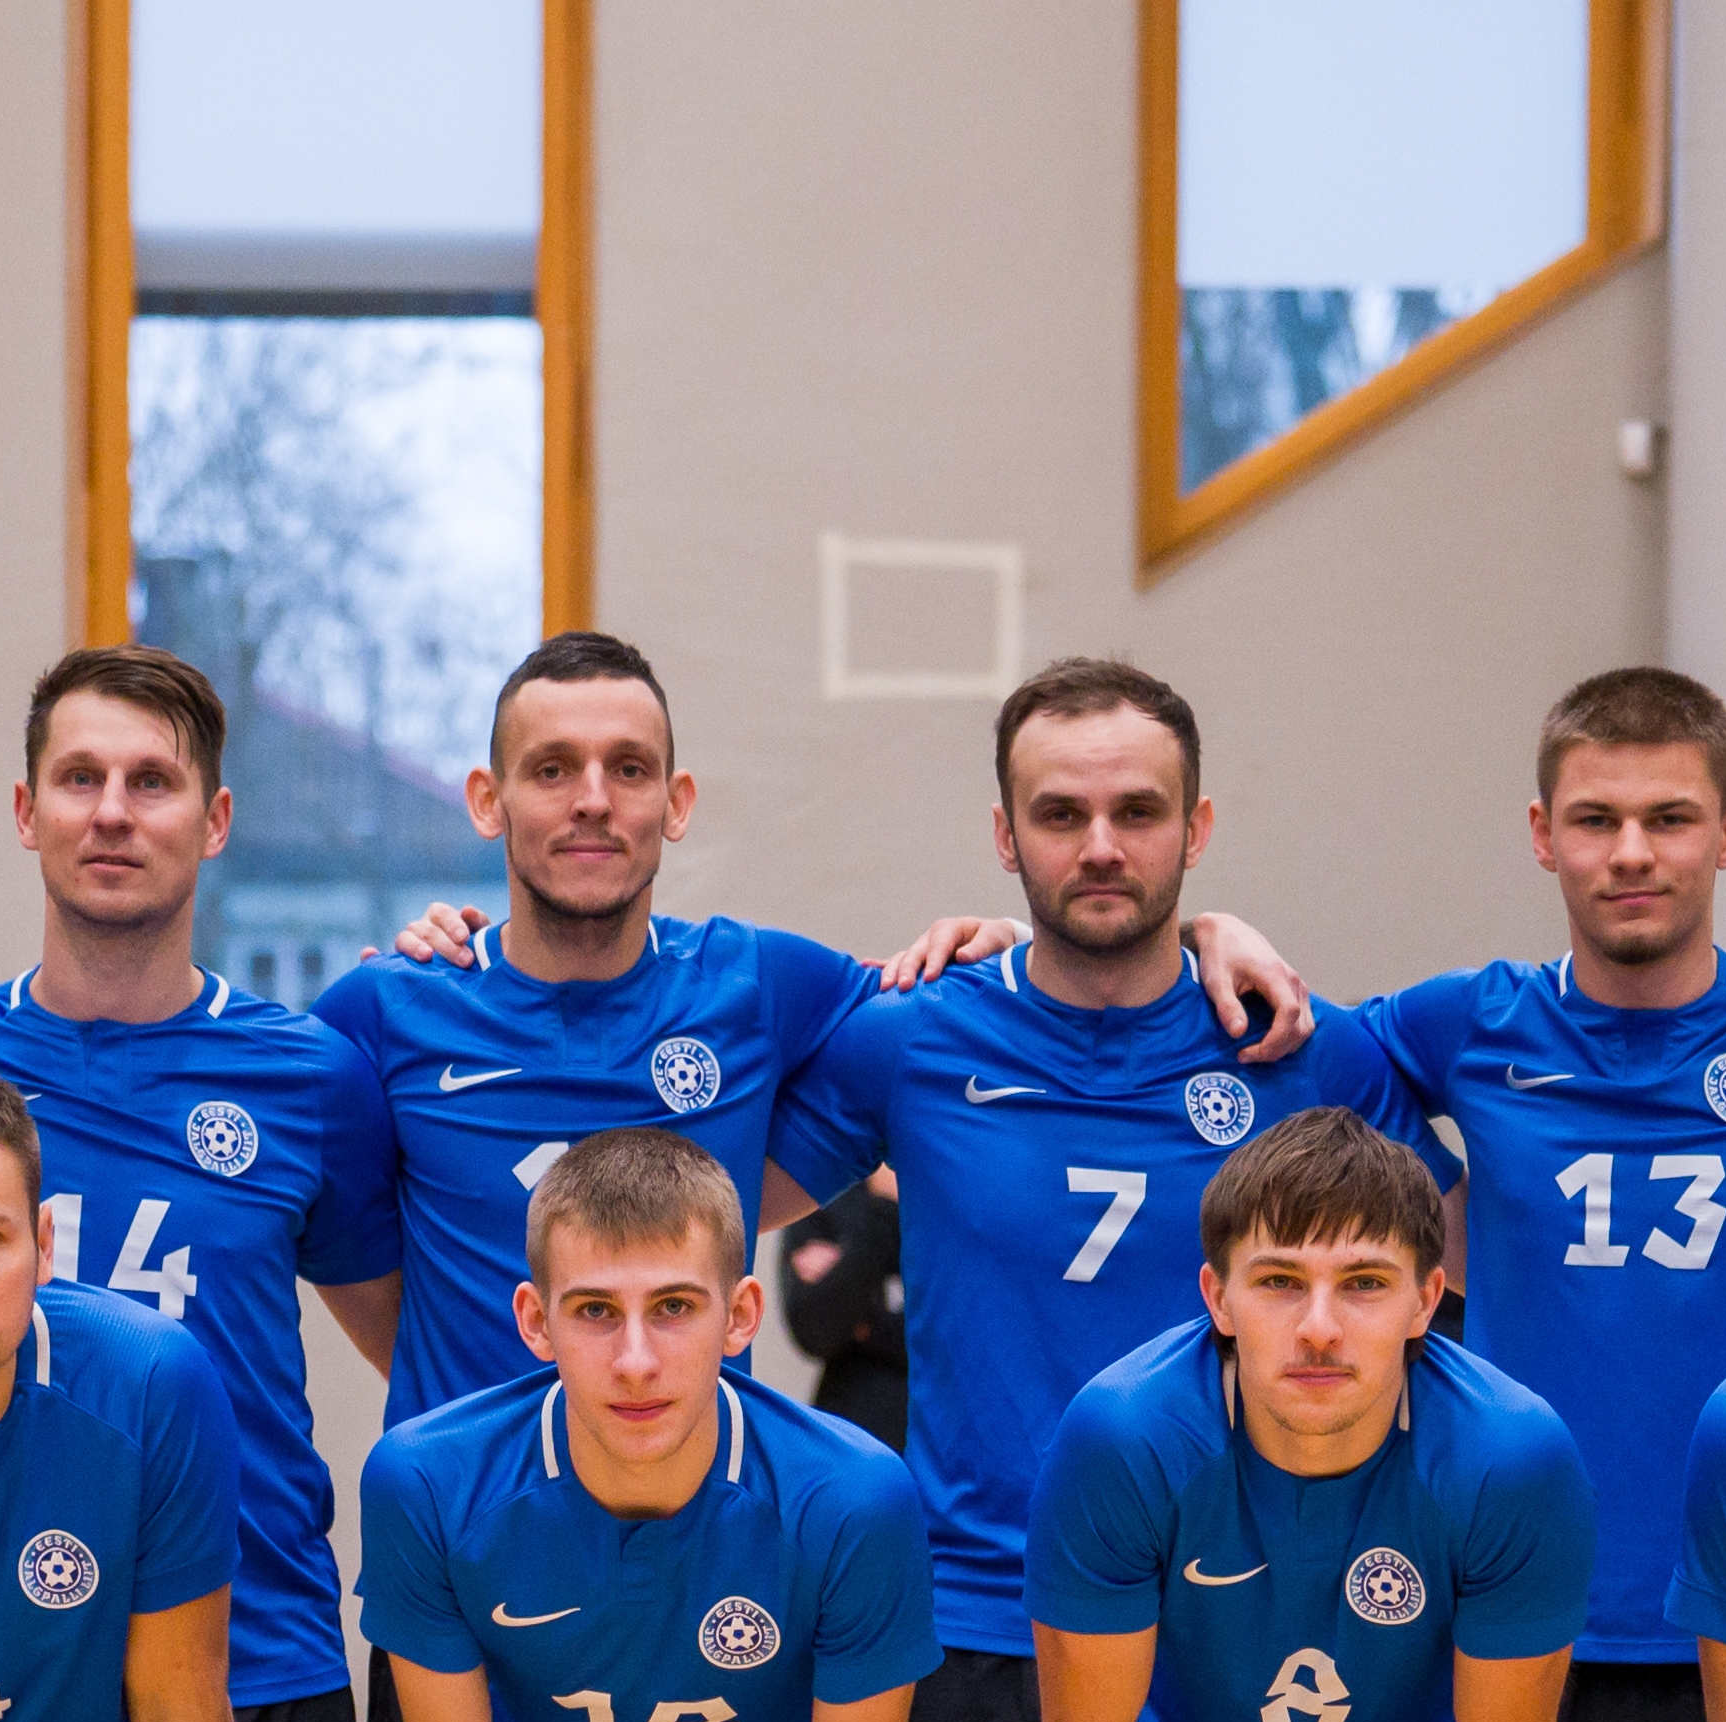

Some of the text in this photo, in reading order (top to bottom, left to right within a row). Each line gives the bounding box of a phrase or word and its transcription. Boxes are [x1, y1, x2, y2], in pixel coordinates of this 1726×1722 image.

[659, 1043, 697, 1059] EESTI
[1195, 1077, 1232, 1090] EESTI
[201, 1107, 241, 1121] EESTI
[240, 1131, 253, 1159] LIIT
[1063, 1167, 1147, 1281] 7
[1555, 1153, 1726, 1269] 13
[39, 1193, 197, 1320] 14
[24, 1536, 93, 1604] EESTI JALGPALLI LIIT
[1351, 1553, 1420, 1620] EESTI JALGPALLI LIIT
[704, 1601, 774, 1664] EESTI JALGPALLI LIIT
